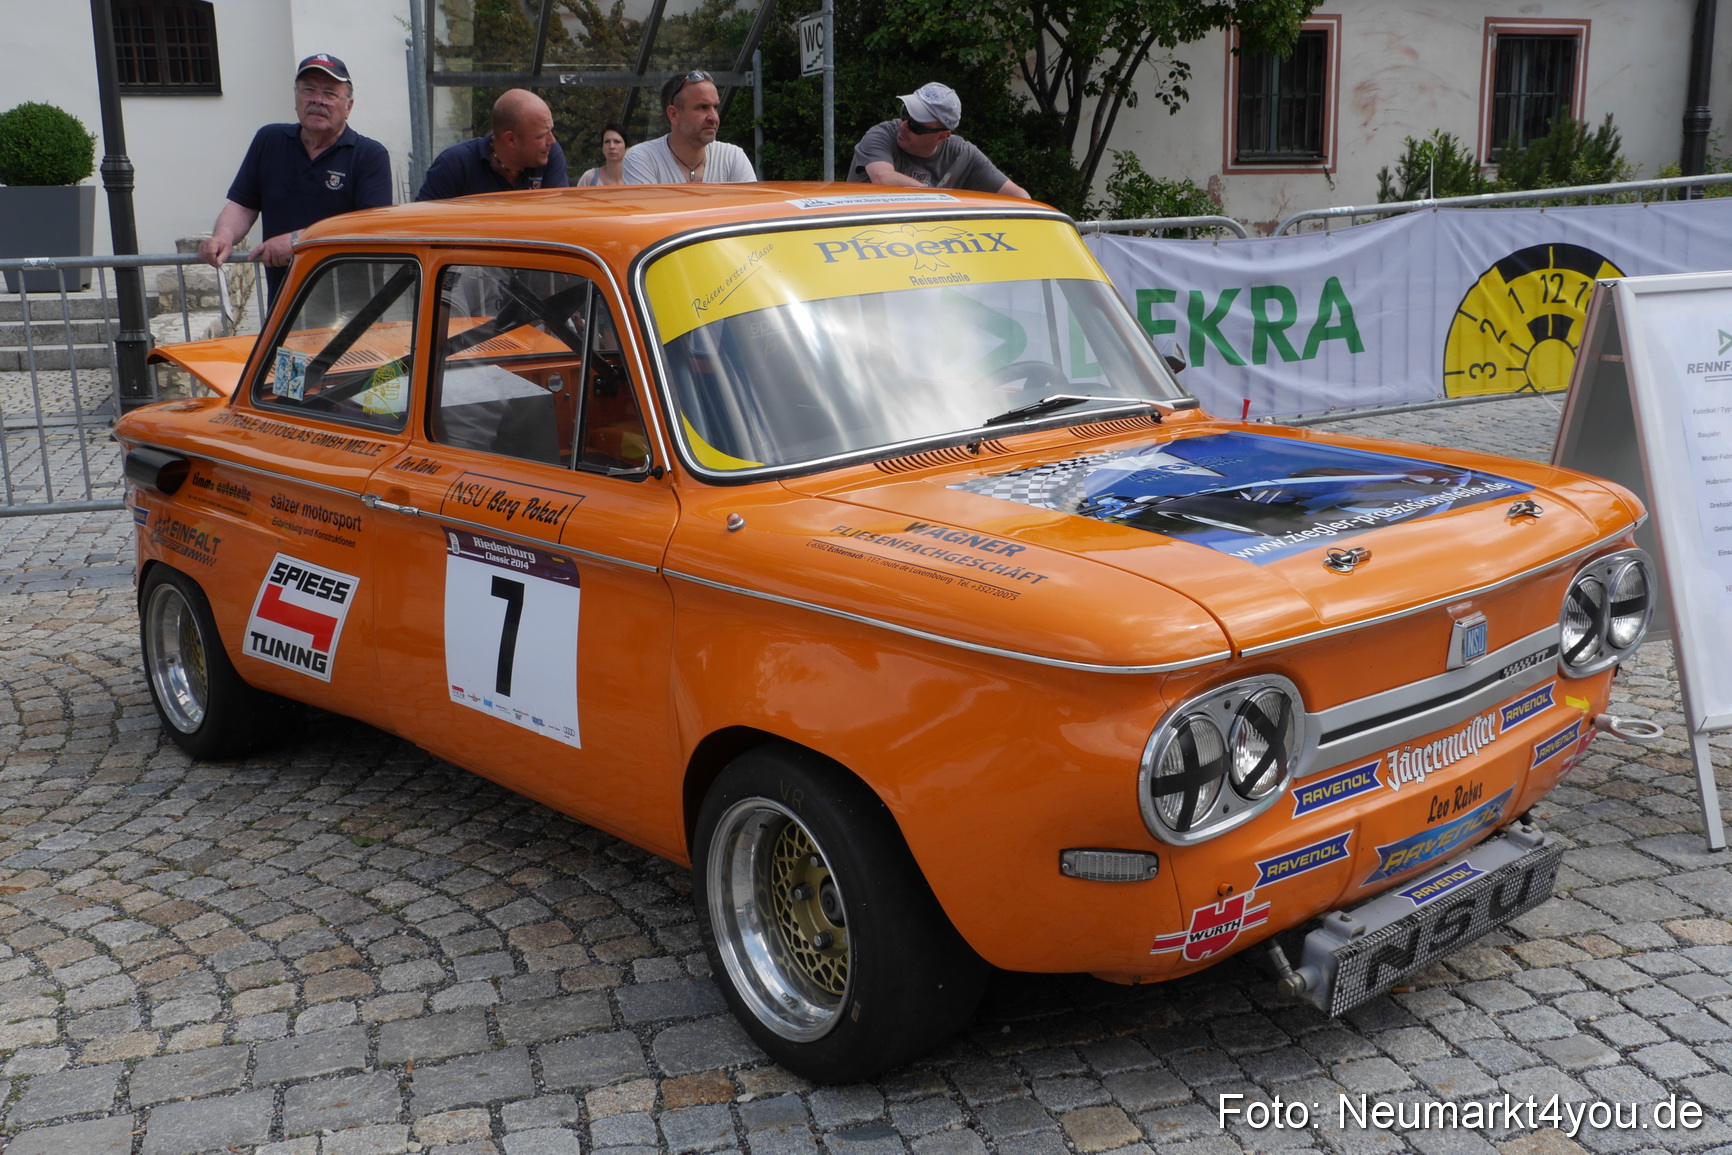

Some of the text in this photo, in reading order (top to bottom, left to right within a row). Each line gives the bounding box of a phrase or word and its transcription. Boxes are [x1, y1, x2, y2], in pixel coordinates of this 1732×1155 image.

[803, 21, 823, 53] WC
[691, 243, 775, 319] Reisen erster Klasse
[909, 273, 970, 286] Reisemobile
[1540, 272, 1567, 304] 12
[1508, 287, 1525, 315] 1
[1479, 318, 1508, 344] 2
[1469, 361, 1497, 380] 3
[1687, 360, 1732, 375] RENNF
[208, 412, 387, 457] ZENTRALE AUTOGLAS GMBH MELLE
[192, 472, 214, 491] timms
[270, 492, 300, 514] sälzer
[301, 504, 362, 533] motorsport
[449, 481, 568, 525] NSU Berg Pokal
[170, 520, 221, 555] EINFALT
[271, 517, 356, 549] Entwicklung und Konstruktionen
[472, 536, 536, 564] Riedenburg
[903, 521, 1027, 558] WAGNER
[485, 551, 529, 570] Classic 2014
[827, 546, 864, 560] Echternach
[880, 560, 900, 570] route
[899, 563, 910, 572] de
[908, 566, 954, 585] Luxembourg
[957, 578, 970, 588] Tel.
[829, 525, 1049, 586] FLIESENFACHGESCHÄFT
[269, 561, 351, 605] SPIESS
[250, 631, 328, 674] TUNING
[490, 574, 525, 698] 7
[1467, 623, 1485, 657] NSU
[1505, 692, 1548, 723] RAVENOL
[1386, 711, 1497, 793] Jägermeister
[1538, 728, 1576, 760] RAVENOL
[1302, 772, 1371, 806] RAVENOL
[1427, 778, 1484, 825] Leo Rabus
[1382, 804, 1498, 873] RAVENOL
[1266, 843, 1341, 878] RAVENOL
[1410, 866, 1473, 900] RAVENOL
[1189, 918, 1243, 943] WÜRTH
